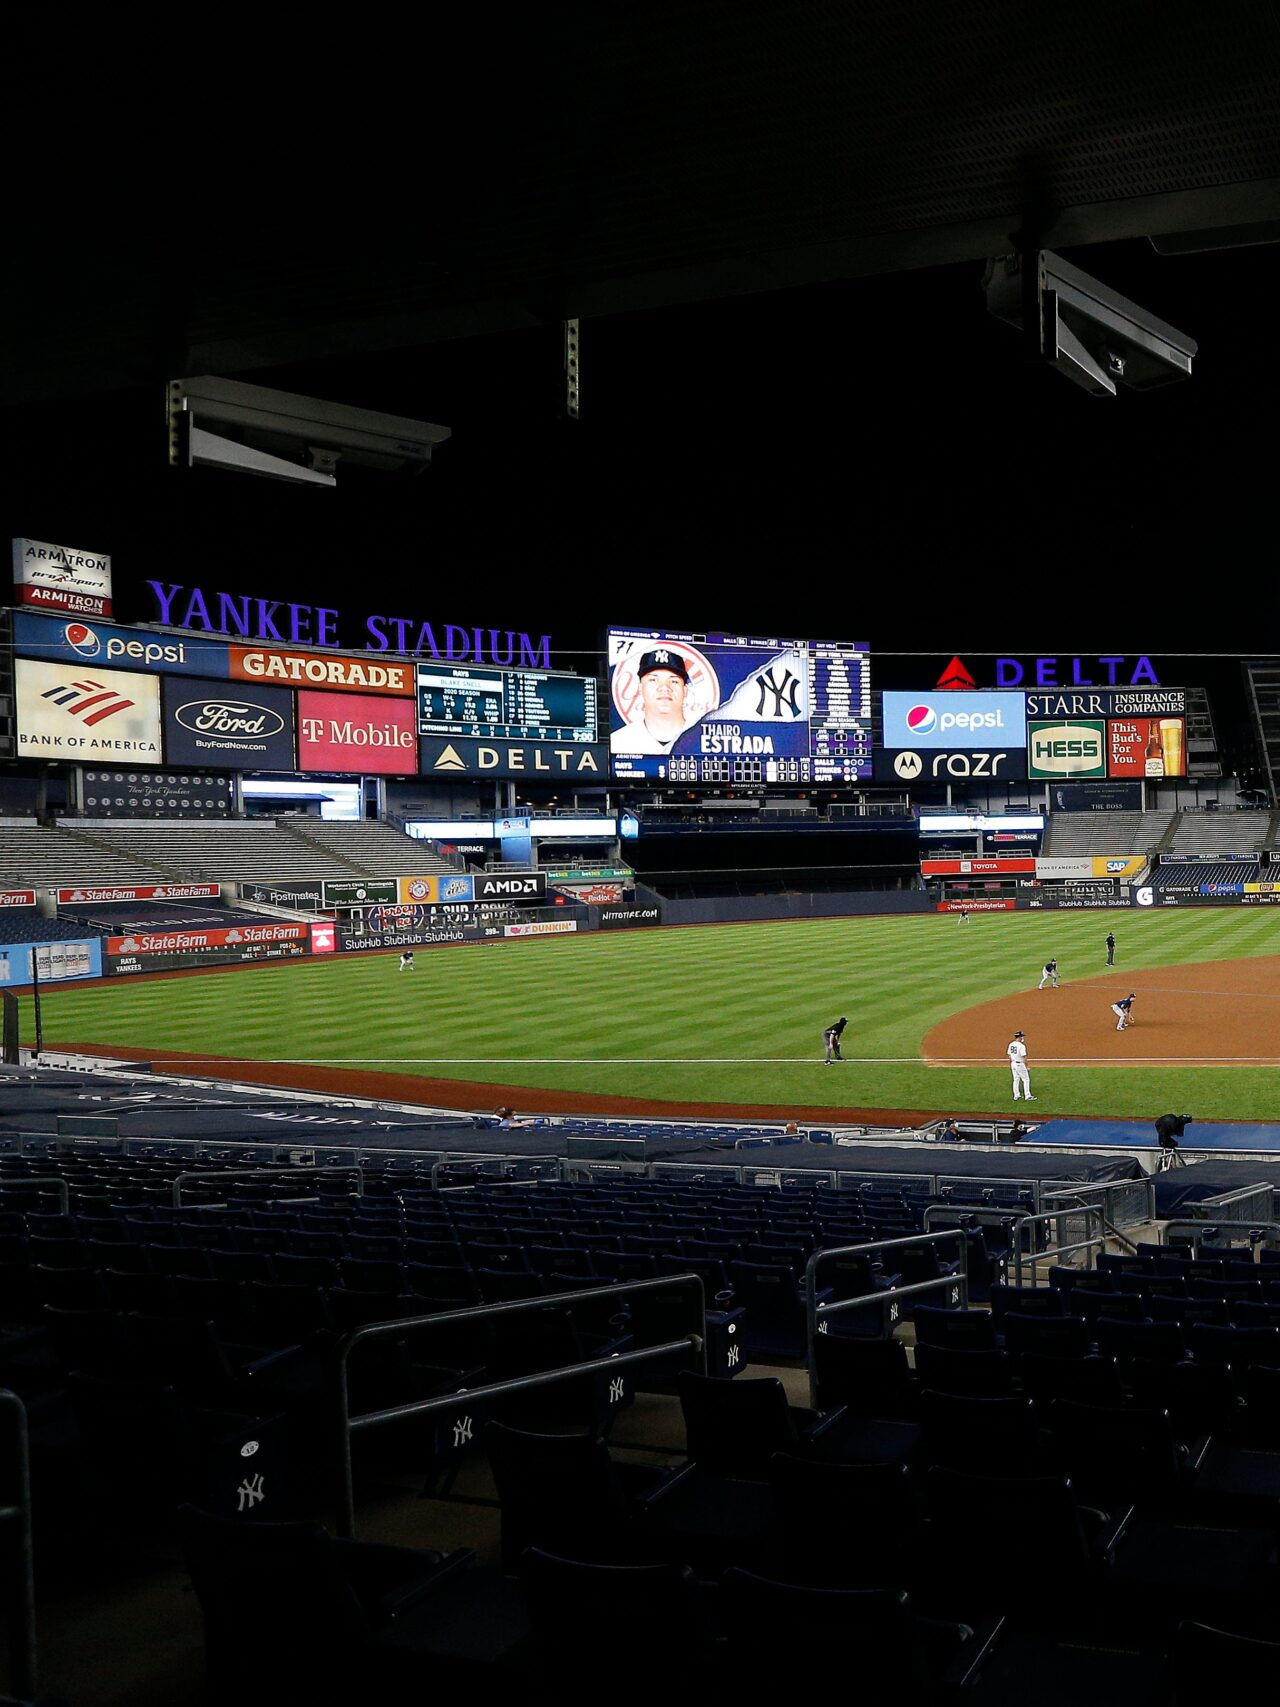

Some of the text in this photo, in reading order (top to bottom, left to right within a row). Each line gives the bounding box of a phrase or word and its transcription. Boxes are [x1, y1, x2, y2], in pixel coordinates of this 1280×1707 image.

[26, 547, 106, 571] ARMITRON
[31, 589, 103, 608] ARMITRON
[68, 603, 103, 614] WATCHES
[146, 580, 552, 669] YANKEE STADIUM
[107, 638, 185, 664] pepsi
[242, 653, 404, 689] GATORADE
[996, 656, 1159, 686] DELTA
[1027, 693, 1184, 715] STARR INSURANCE
[1115, 702, 1184, 713] COMPANIES
[195, 705, 265, 735] Ford
[940, 709, 1003, 731] pepsi
[1112, 723, 1137, 733] This
[329, 721, 413, 748] Mobile
[700, 724, 740, 737] THAIRO
[1112, 733, 1142, 743] Bud's
[20, 734, 157, 752] BANK OF AMERICA
[195, 739, 267, 751] BuyFordNow.com
[700, 736, 774, 754] ESTRADA
[1036, 740, 1098, 758] HESS
[1112, 744, 1131, 753] For
[478, 747, 598, 772] DELTA
[932, 753, 1007, 777] razr
[1113, 754, 1137, 764] You.
[1107, 862, 1126, 872] SAP
[86, 890, 136, 900] StateFarm
[166, 887, 211, 896] StateFarm
[483, 881, 522, 894] AMD
[270, 892, 319, 901] Postmates
[602, 909, 658, 921] NITTOTIRE.COM
[244, 927, 299, 942] StateFarm
[532, 923, 571, 932] DUNKIN'
[141, 934, 208, 951] StateFarm
[345, 931, 463, 950] StubHub StubHub StubHub
[116, 964, 142, 972] YANKEES
